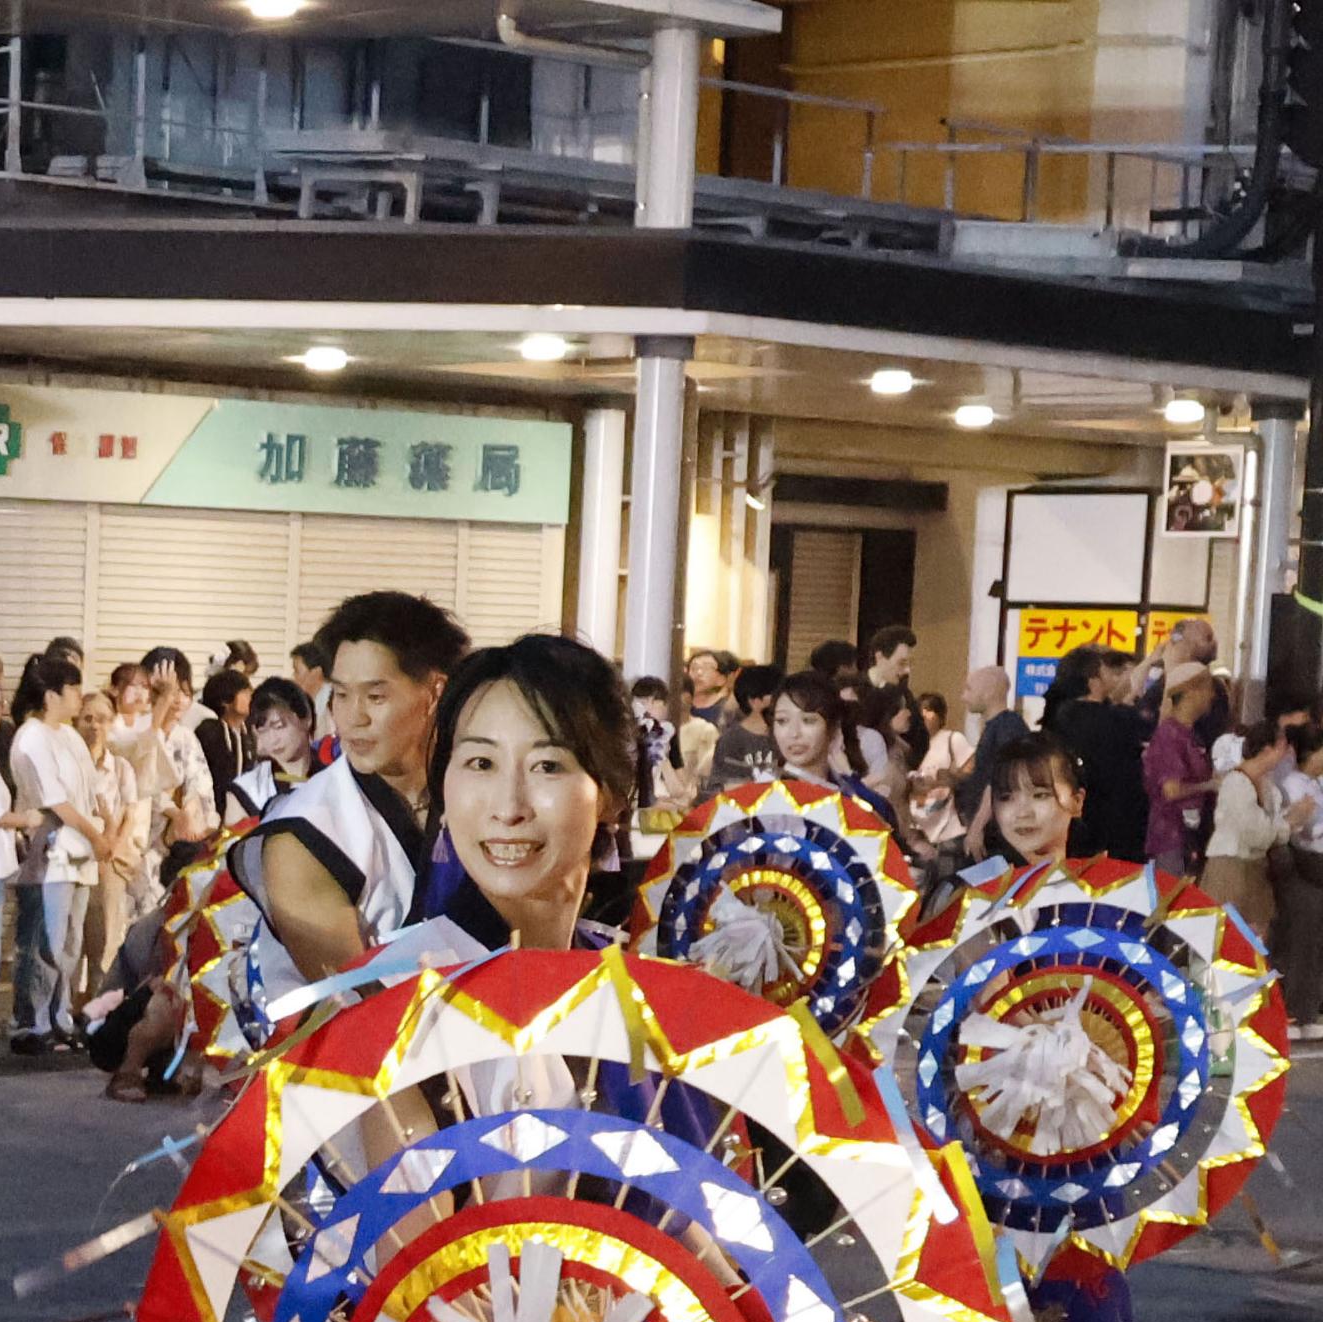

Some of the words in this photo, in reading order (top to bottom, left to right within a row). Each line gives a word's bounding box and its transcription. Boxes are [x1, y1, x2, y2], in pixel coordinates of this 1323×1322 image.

[258, 432, 520, 497] 加藤薬局
[1025, 617, 1127, 649] テナント
